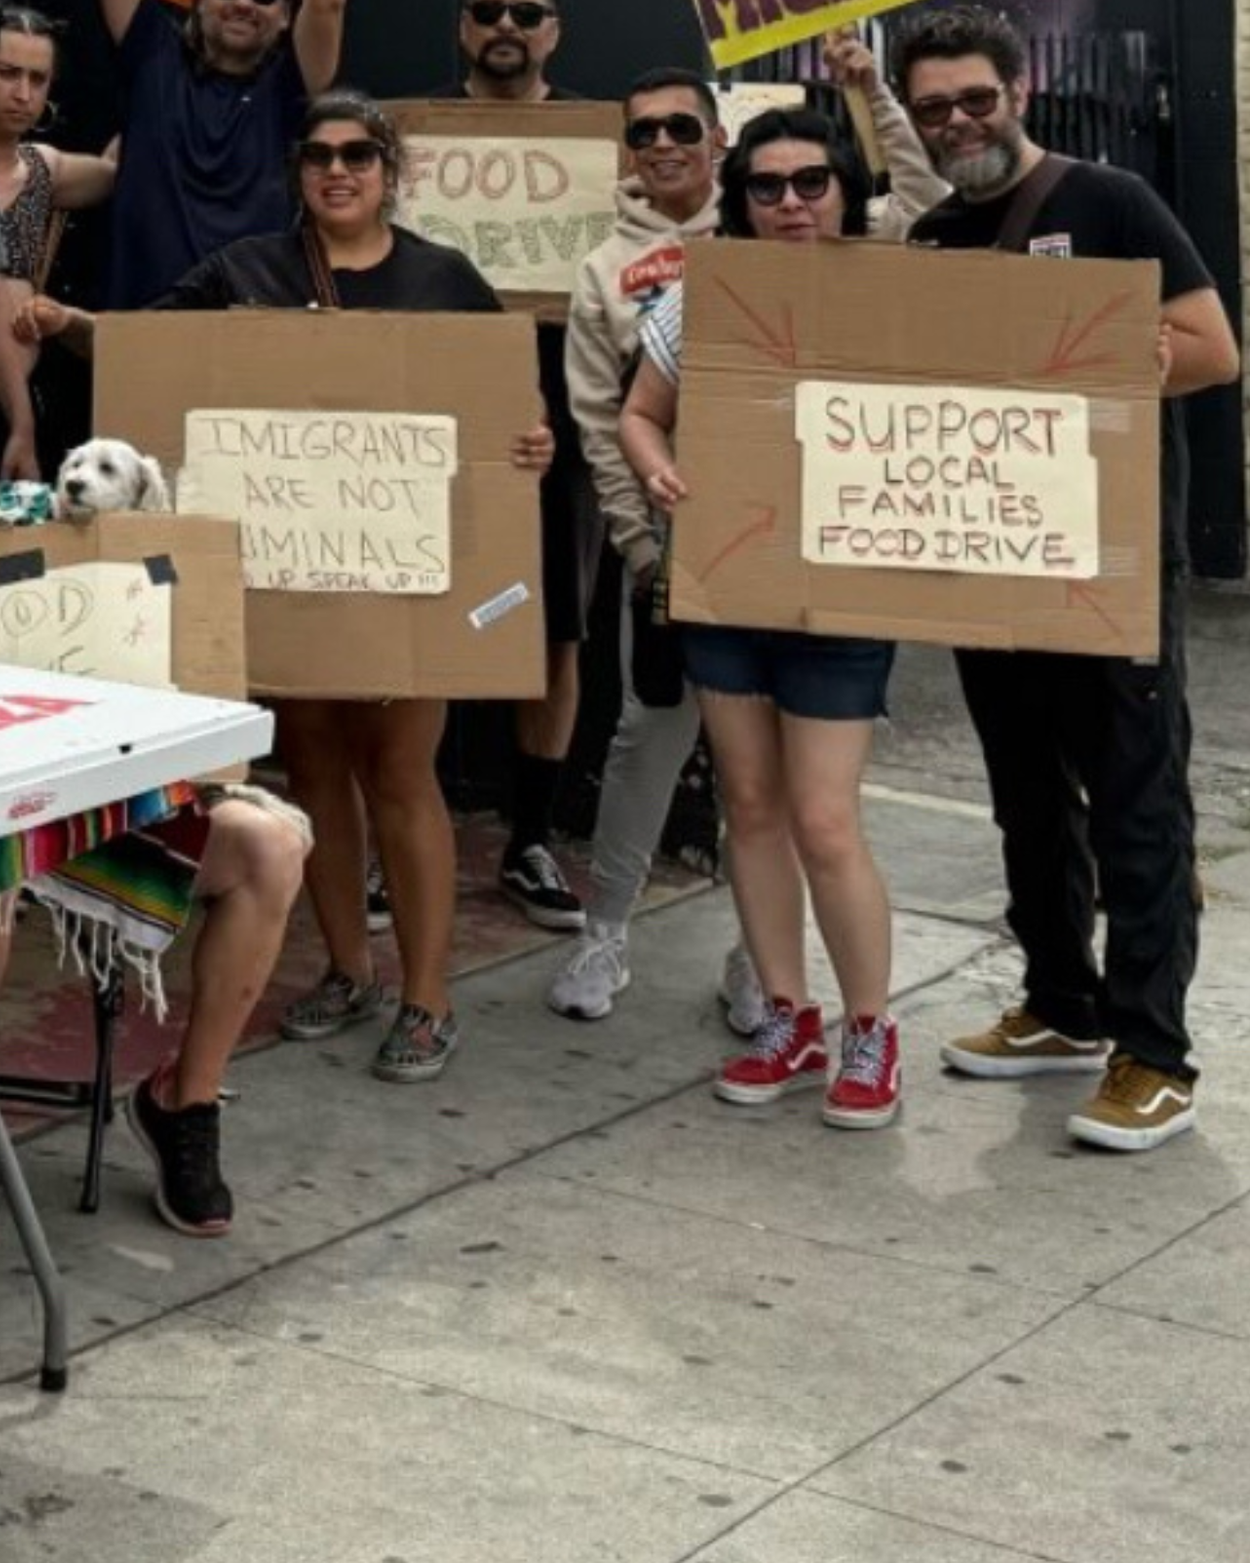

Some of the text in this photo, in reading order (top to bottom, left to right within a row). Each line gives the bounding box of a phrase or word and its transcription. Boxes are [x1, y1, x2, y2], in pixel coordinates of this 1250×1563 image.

[401, 146, 570, 204] FOOD
[198, 416, 448, 468] IMIGRANTS
[825, 395, 1063, 457] SUPPORT
[244, 472, 422, 518] ARE NOT
[884, 455, 1015, 490] LOCAL
[838, 484, 1044, 527] FAMILIES
[242, 524, 445, 574] IMINALS
